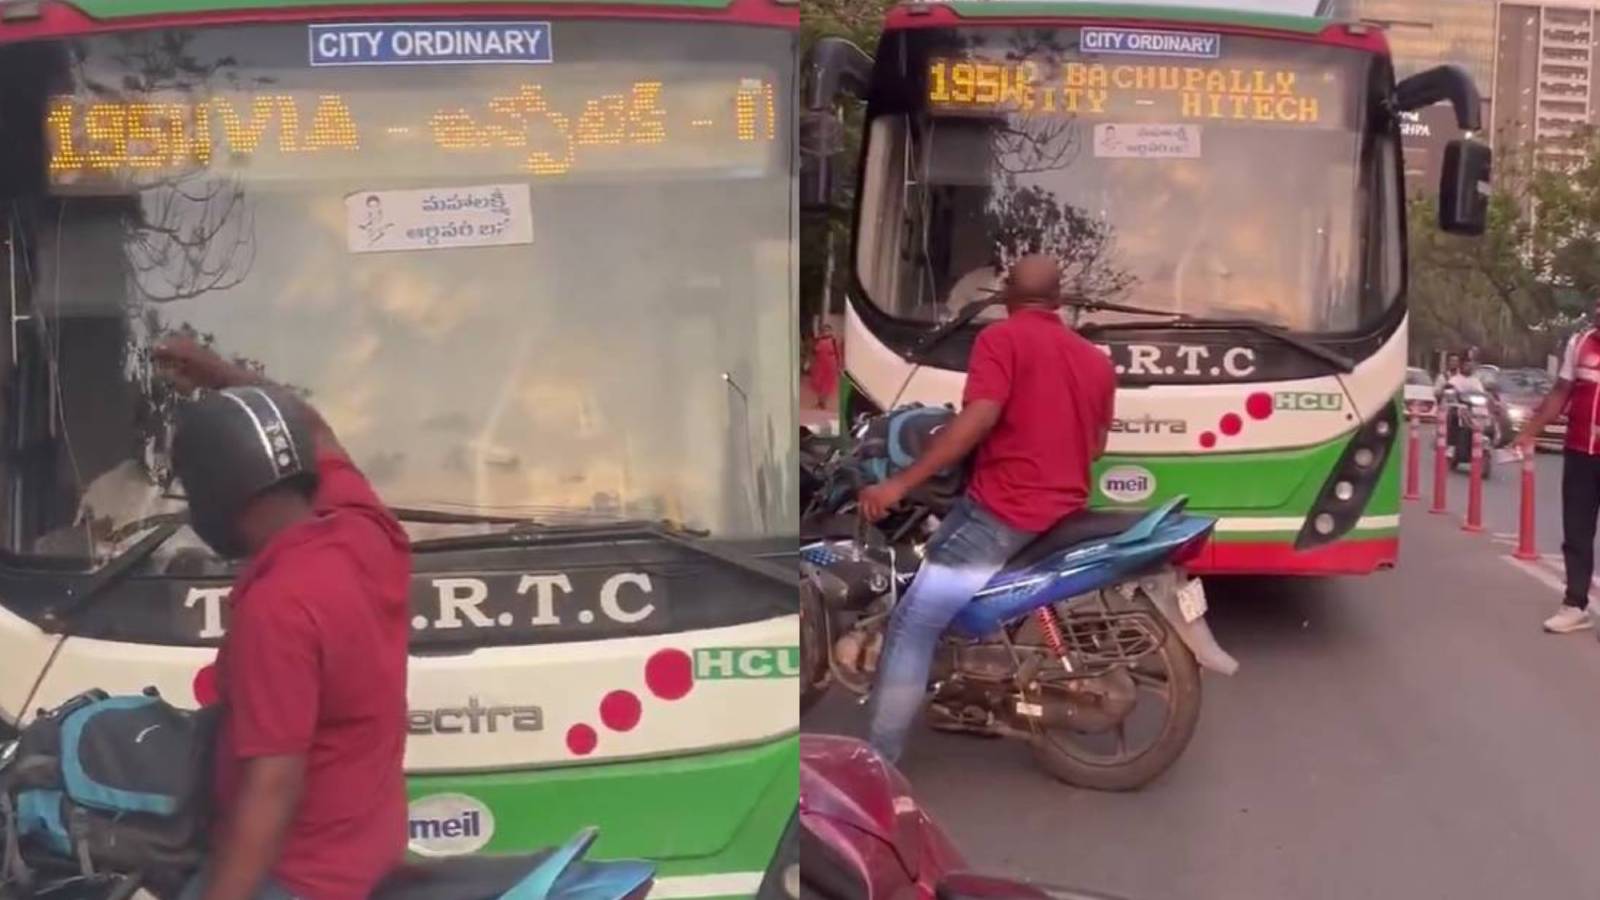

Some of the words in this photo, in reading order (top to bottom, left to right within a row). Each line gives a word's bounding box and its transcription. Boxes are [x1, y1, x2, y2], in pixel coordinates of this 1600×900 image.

[318, 31, 383, 57] CITY
[391, 29, 542, 56] ORDINARY
[1085, 31, 1124, 48] CITY
[1127, 33, 1214, 53] ORDINARY
[929, 62, 1025, 104] 195W
[1065, 62, 1296, 96] BACHUPALLY
[1022, 86, 1105, 113] CITY
[1181, 90, 1319, 122] HITECH
[211, 95, 361, 152] VIA
[1275, 393, 1342, 410] HCU
[1109, 413, 1187, 434] ectra
[1105, 475, 1149, 493] meil
[407, 695, 544, 735] ectra
[408, 810, 480, 839] meil
